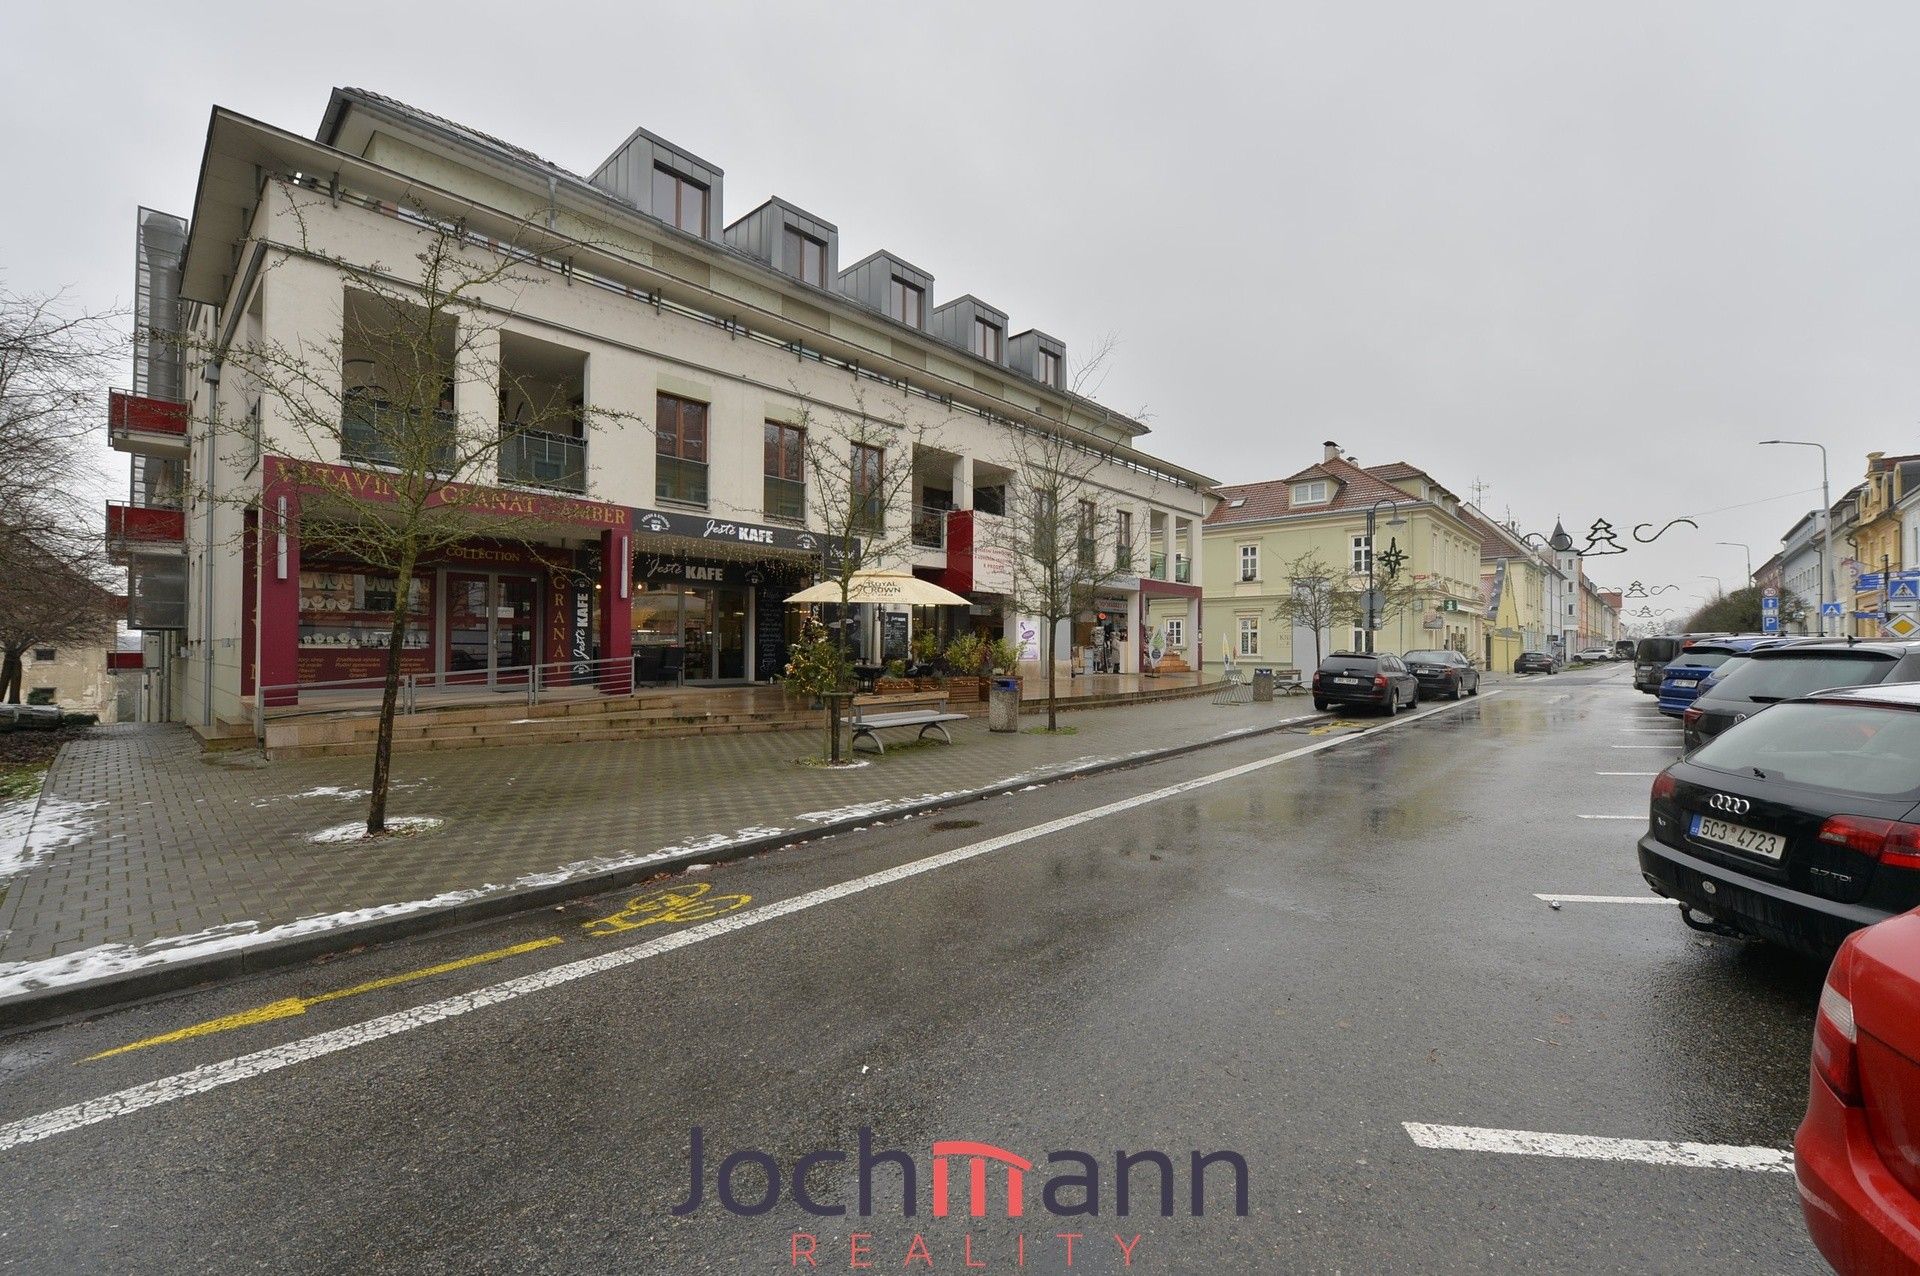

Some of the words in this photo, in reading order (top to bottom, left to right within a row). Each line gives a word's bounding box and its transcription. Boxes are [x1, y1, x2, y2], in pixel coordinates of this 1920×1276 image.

[738, 526, 774, 543] KAFE
[685, 565, 723, 581] KAFE
[577, 593, 589, 627] KAFE
[1765, 617, 1776, 627] P
[1701, 819, 1728, 840] 5C3
[1737, 829, 1777, 854] 4723
